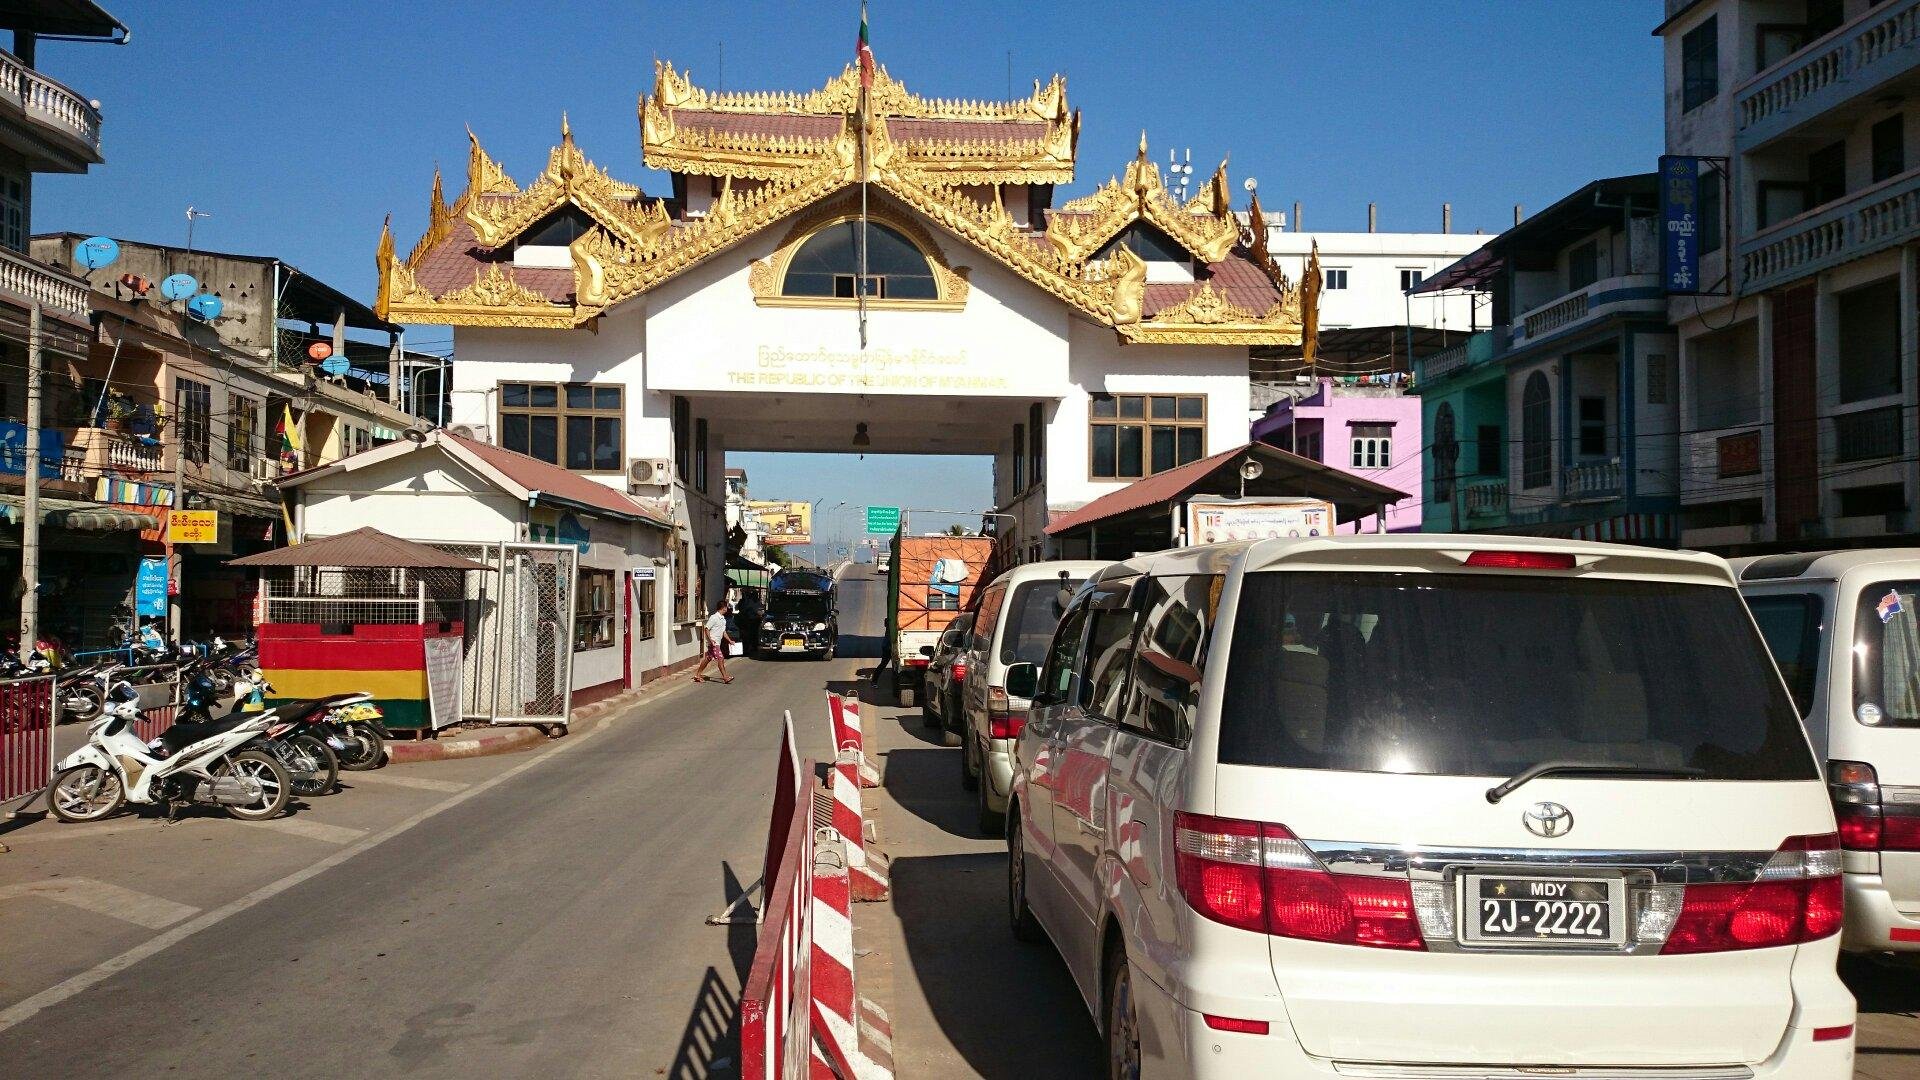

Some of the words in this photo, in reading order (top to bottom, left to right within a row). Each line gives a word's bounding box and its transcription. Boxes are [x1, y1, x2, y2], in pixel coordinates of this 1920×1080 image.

[728, 371, 755, 385] THE
[759, 372, 825, 386] REPUBLIC
[829, 373, 846, 386] OF
[919, 375, 937, 388] OF
[1530, 882, 1567, 897] MDY
[1483, 900, 1603, 936] 2J-2222
